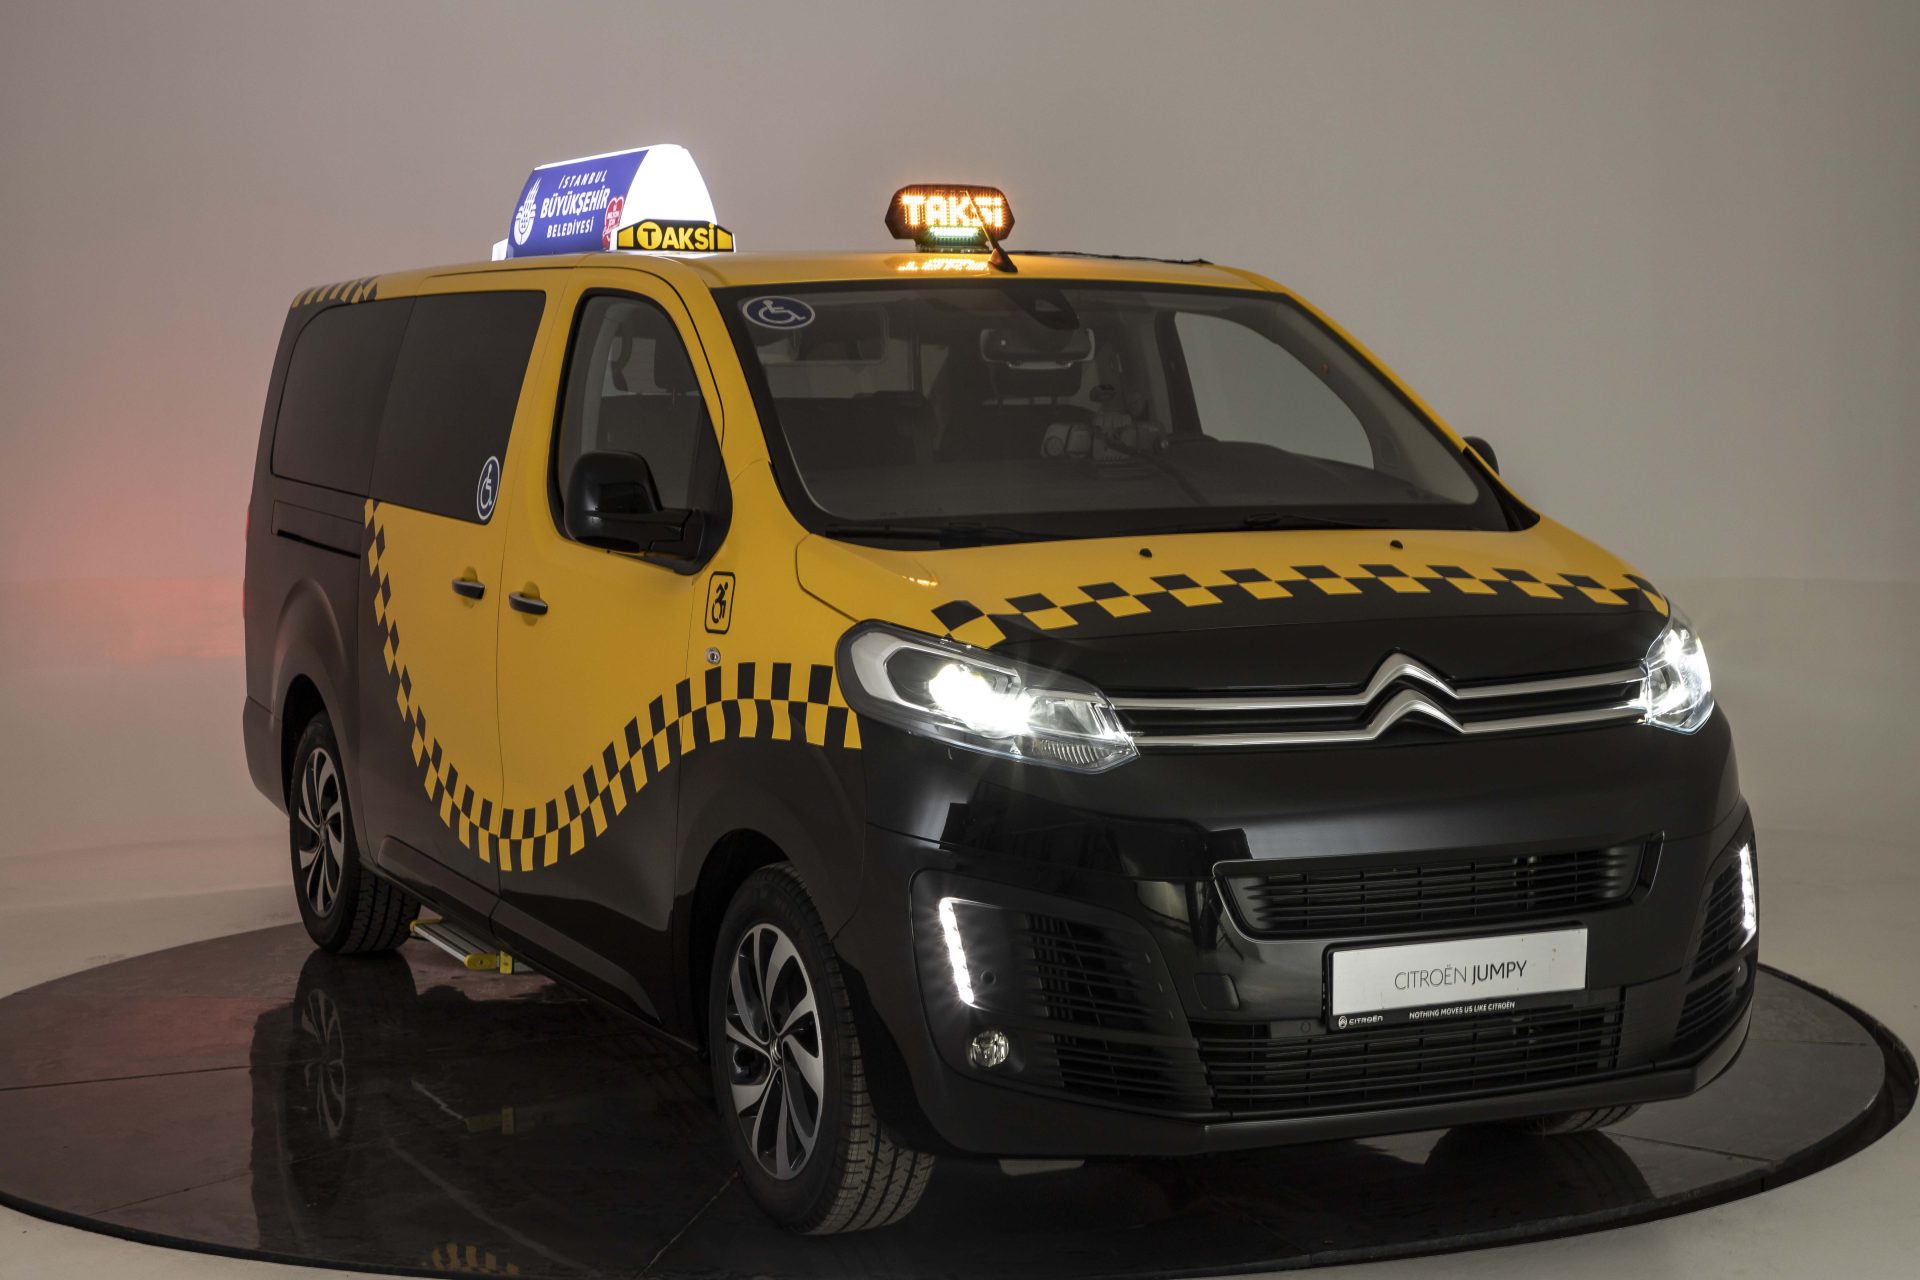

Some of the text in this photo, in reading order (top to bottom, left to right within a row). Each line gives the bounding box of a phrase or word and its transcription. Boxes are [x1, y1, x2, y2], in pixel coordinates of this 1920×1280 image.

[558, 169, 608, 190] İSTANBUL
[540, 185, 611, 219] BÜYÜKŞEHİR
[546, 216, 595, 239] BELEDİYESİ
[637, 221, 715, 250] TAKSİ
[1394, 960, 1527, 990] CITROËN JUMPY
[1409, 1008, 1440, 1020] NOTHING
[1440, 1006, 1463, 1016] MOVES
[1464, 1005, 1473, 1014] US
[1474, 1003, 1487, 1013] LIKE
